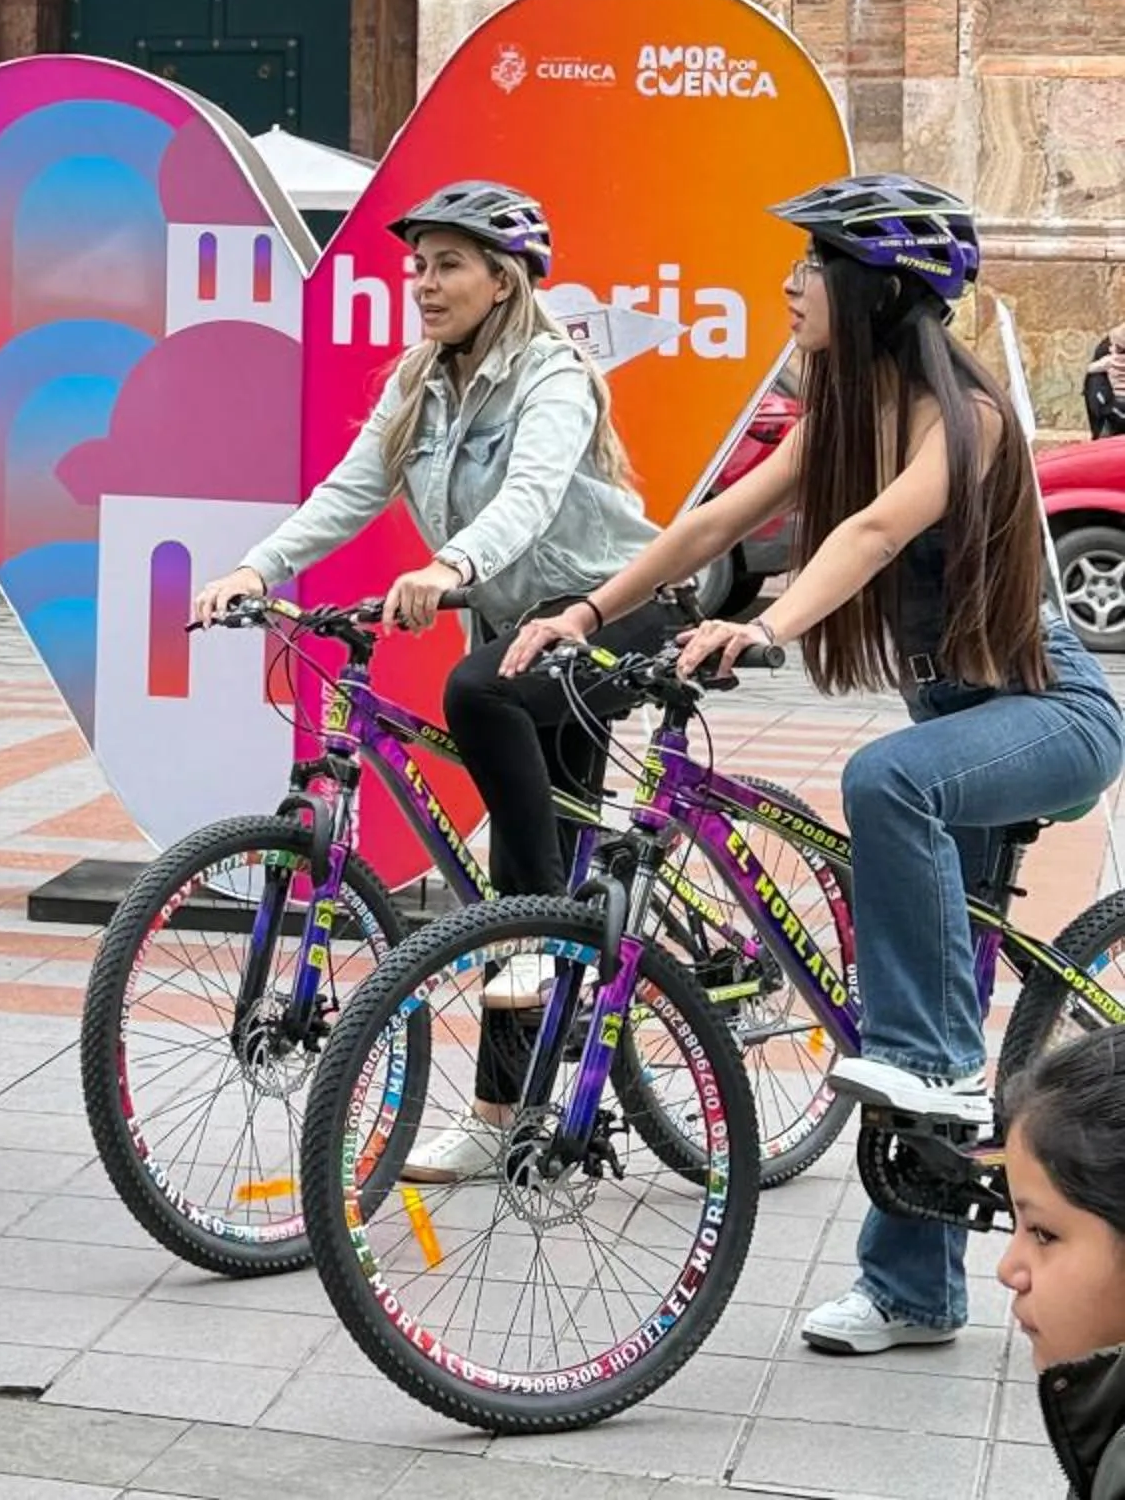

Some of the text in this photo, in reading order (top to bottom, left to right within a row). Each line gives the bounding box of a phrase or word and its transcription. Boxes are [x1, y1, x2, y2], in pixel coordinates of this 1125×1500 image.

[536, 63, 616, 80] CUENCA
[636, 45, 757, 71] AMOR POR
[635, 70, 778, 98] CUENCA
[726, 829, 848, 1008] EL MORLACO
